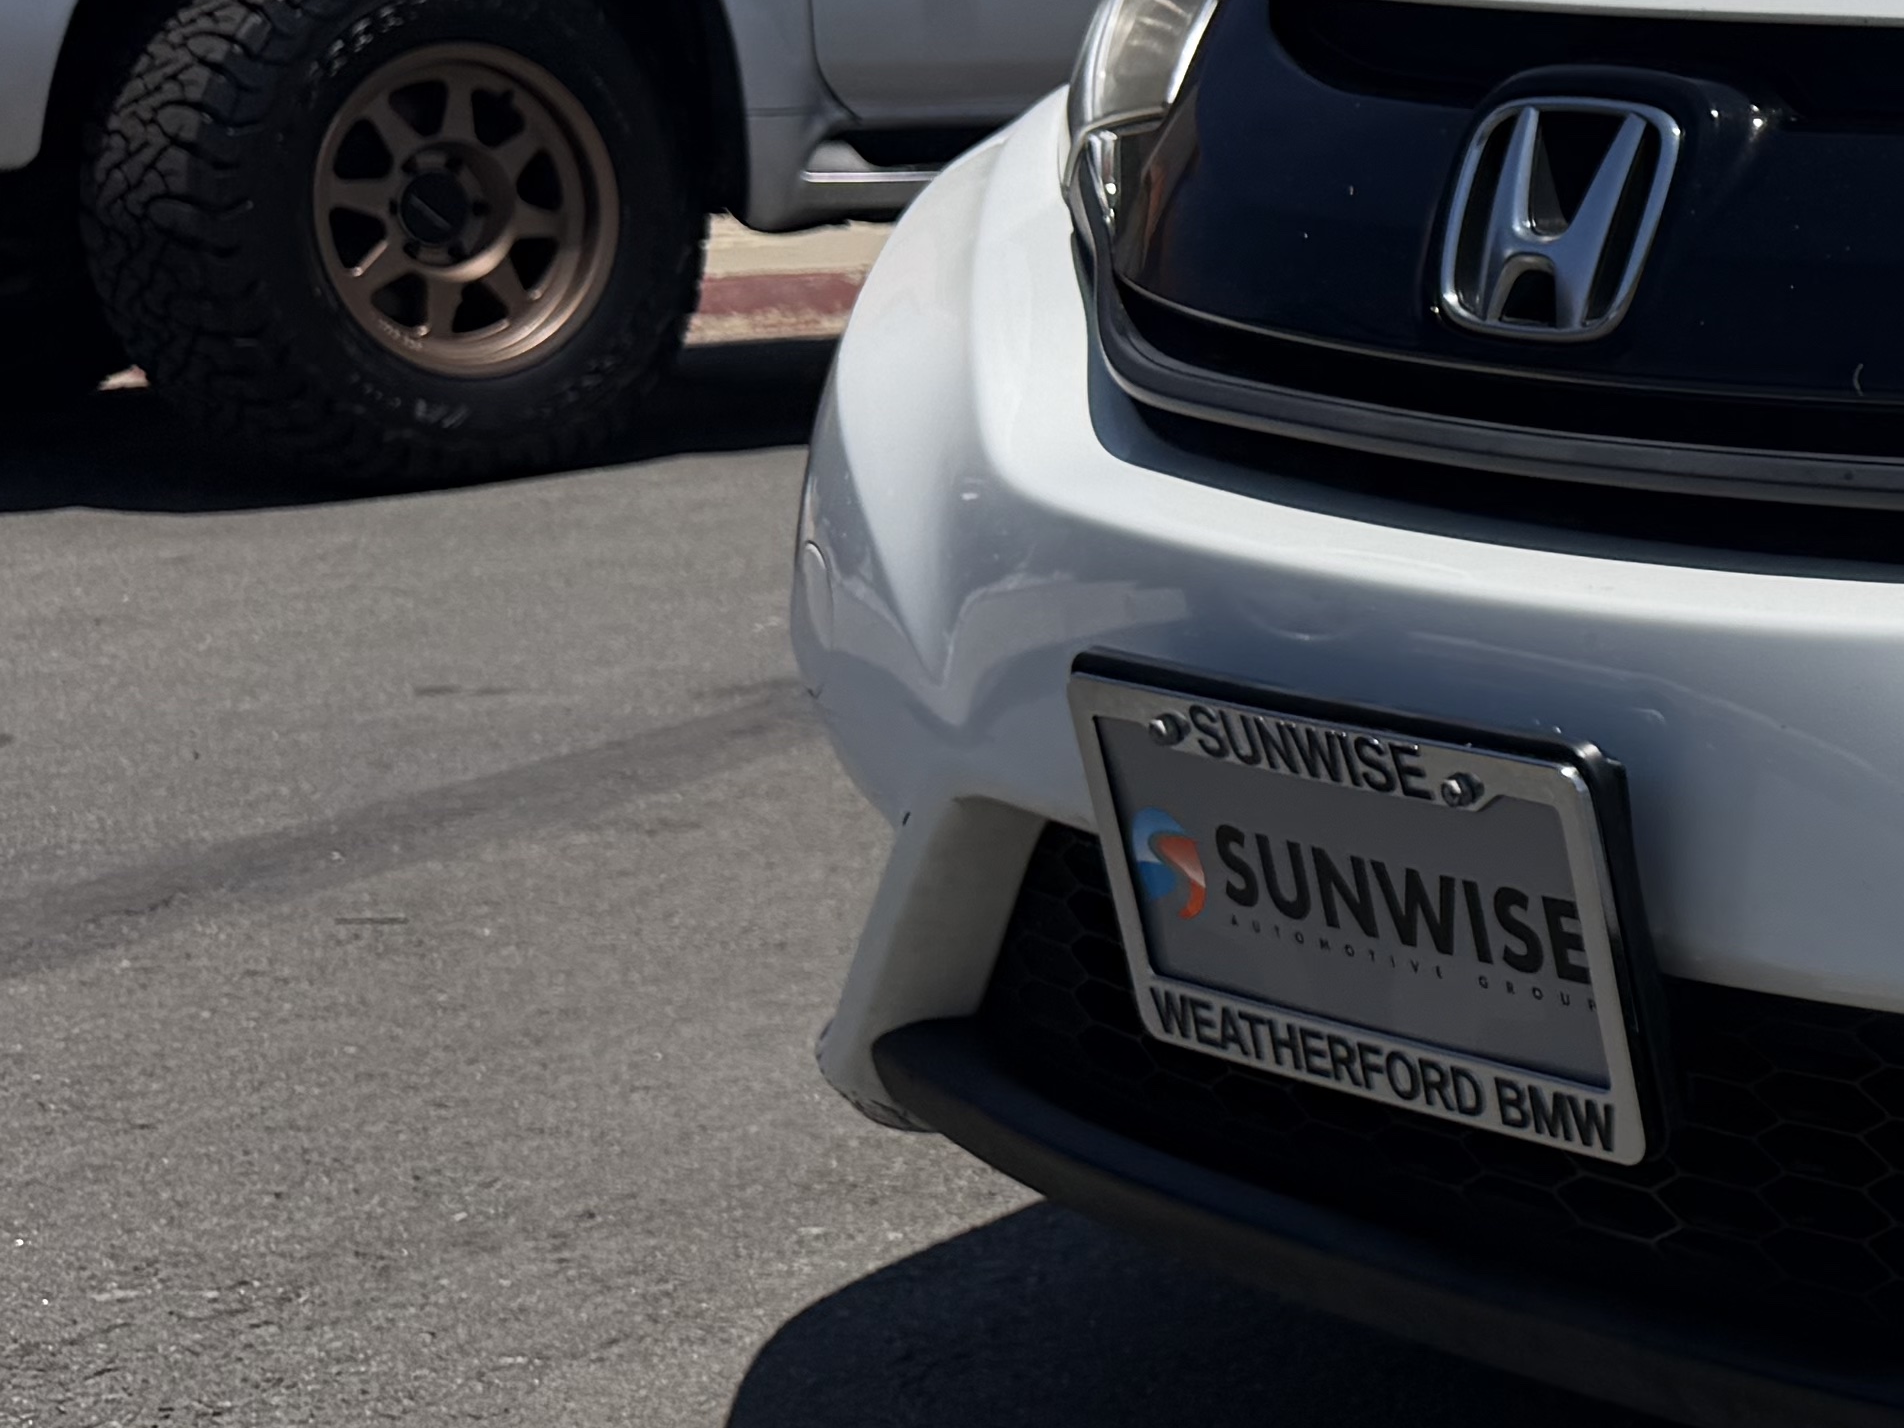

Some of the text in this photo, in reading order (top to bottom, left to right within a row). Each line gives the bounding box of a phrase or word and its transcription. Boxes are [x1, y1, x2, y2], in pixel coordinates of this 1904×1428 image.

[1188, 703, 1435, 801] SUNWISE
[1214, 823, 1591, 985] SUNWISE
[1230, 914, 1442, 980] AUTOMOTIVE
[1149, 987, 1614, 1153] WEATHERFORD BMW
